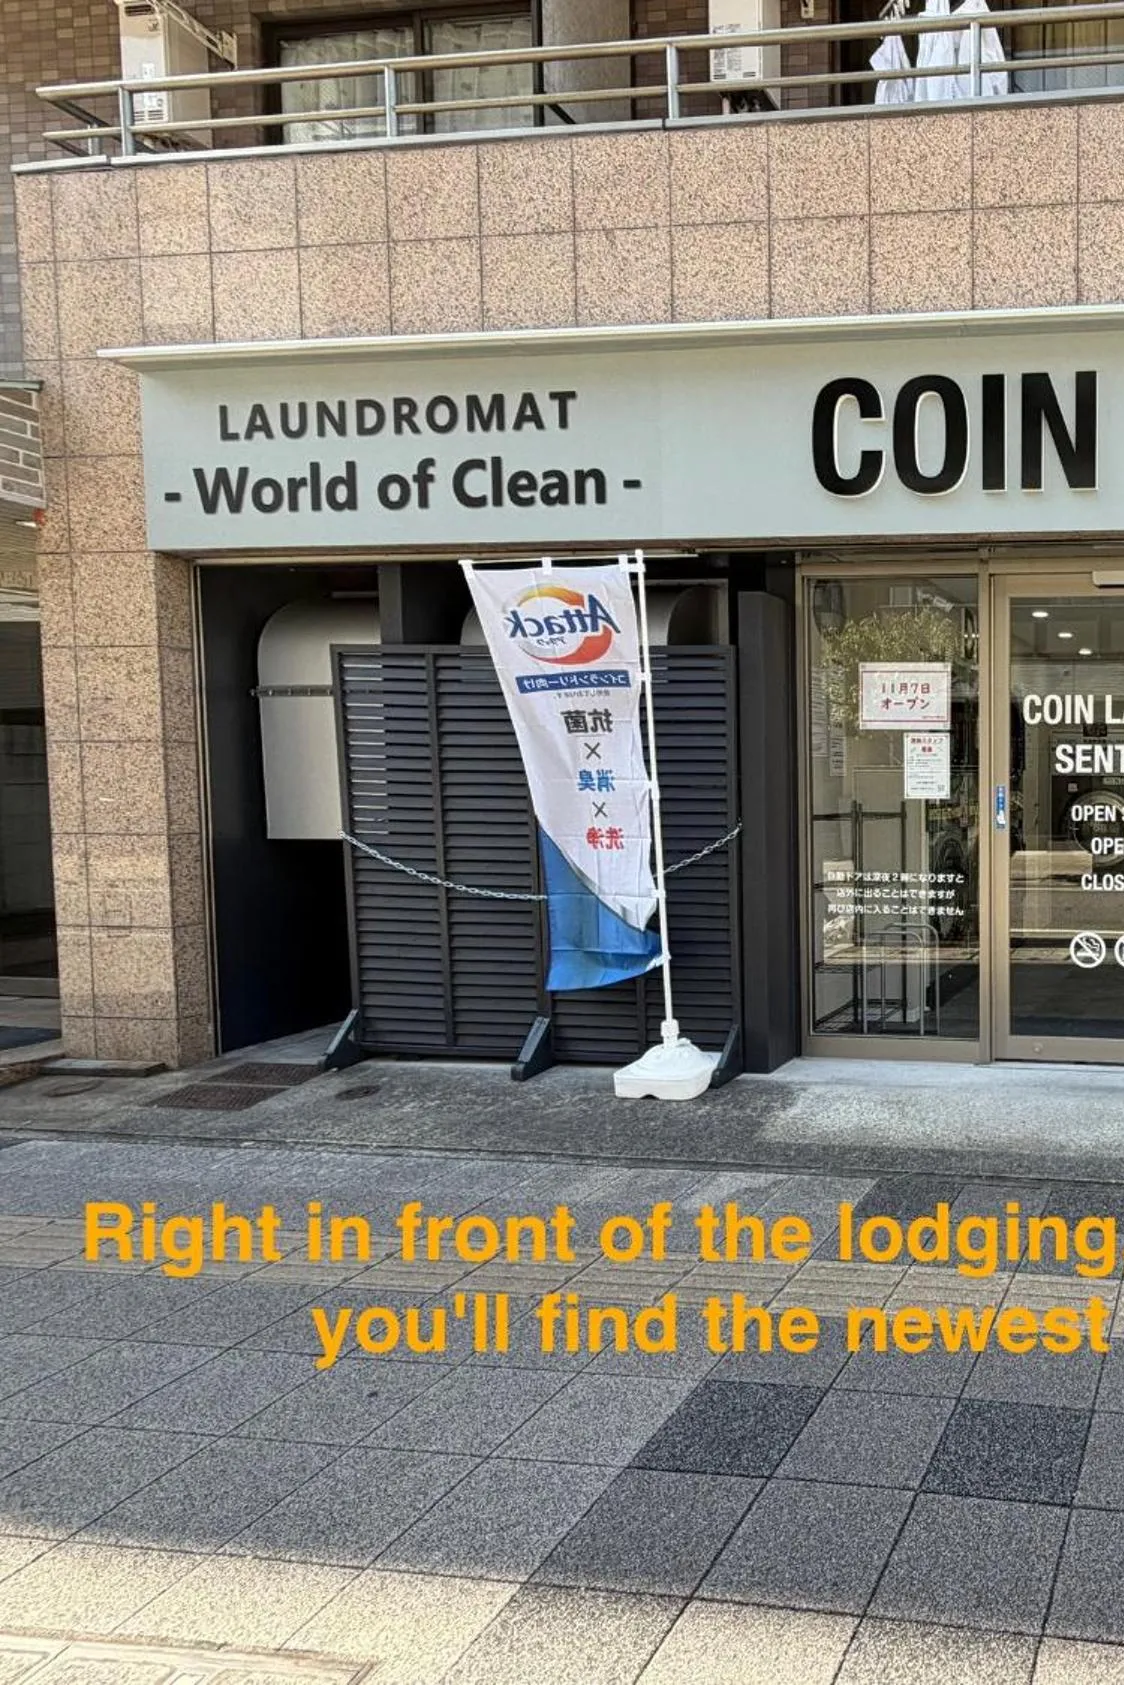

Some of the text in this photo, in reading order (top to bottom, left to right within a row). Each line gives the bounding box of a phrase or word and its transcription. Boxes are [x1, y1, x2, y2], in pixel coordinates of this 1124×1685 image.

[219, 390, 578, 441] LAUNDROMAT
[811, 370, 1098, 497] COIN
[192, 460, 359, 515] World
[377, 456, 436, 511] of
[452, 456, 608, 509] Clean
[880, 697, 930, 711] オープン
[1022, 694, 1095, 725] COIN
[1071, 804, 1117, 823] OPEN
